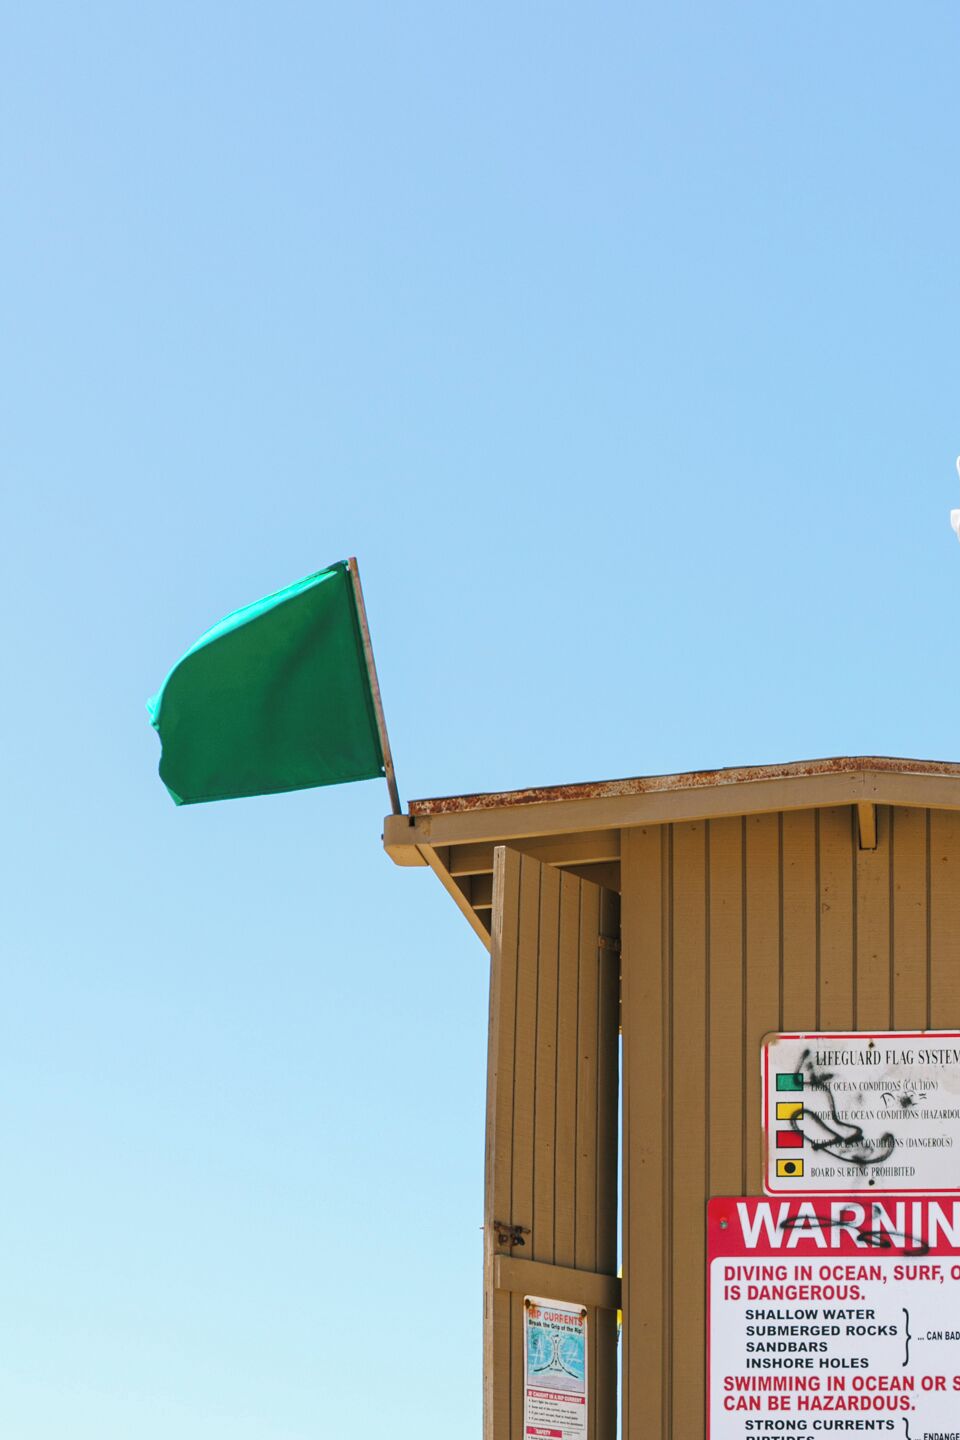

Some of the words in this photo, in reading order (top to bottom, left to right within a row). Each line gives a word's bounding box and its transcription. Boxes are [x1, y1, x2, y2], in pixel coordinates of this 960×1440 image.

[816, 1050, 881, 1066] LIFEGUARD
[886, 1050, 914, 1066] FLAG
[834, 1081, 856, 1092] OCEAN
[859, 1081, 901, 1092] CONDITIONS
[903, 1080, 939, 1092] (CAUTION)
[851, 1110, 875, 1121] OCEAN
[877, 1110, 919, 1121] CONDITIONS
[906, 1138, 953, 1149] (DANGEROUS)
[811, 1167, 835, 1178] BOARD
[837, 1167, 869, 1178] SURFING
[871, 1167, 916, 1178] PROHIBITED
[724, 1266, 788, 1281] DIVING
[794, 1266, 813, 1281] IN
[819, 1266, 887, 1284] OCEAN,
[893, 1265, 944, 1284] SURF,
[724, 1285, 741, 1301] IS
[747, 1285, 866, 1301] DANGEROUS.
[528, 1308, 542, 1320] RIP
[544, 1311, 583, 1328] CURRENTS
[745, 1309, 819, 1320] SHALLOW
[823, 1309, 875, 1320] WATER
[528, 1319, 542, 1327] Break
[551, 1323, 560, 1331] Grip
[746, 1325, 841, 1337] SUBMERGED
[845, 1325, 898, 1337] ROCKS
[926, 1331, 943, 1341] CAN
[746, 1341, 828, 1353] SANDBARS
[746, 1358, 814, 1369] INSHORE
[819, 1358, 869, 1369] HOLES
[723, 1376, 821, 1391] SWIMMING
[827, 1376, 846, 1391] IN
[851, 1376, 915, 1391] OCEAN
[921, 1376, 947, 1391] OR
[723, 1396, 761, 1411] CAN
[767, 1396, 791, 1411] BE
[797, 1396, 916, 1411] HAZARDOUS.
[744, 1419, 808, 1431] STRONG
[812, 1419, 895, 1431] CURRENTS
